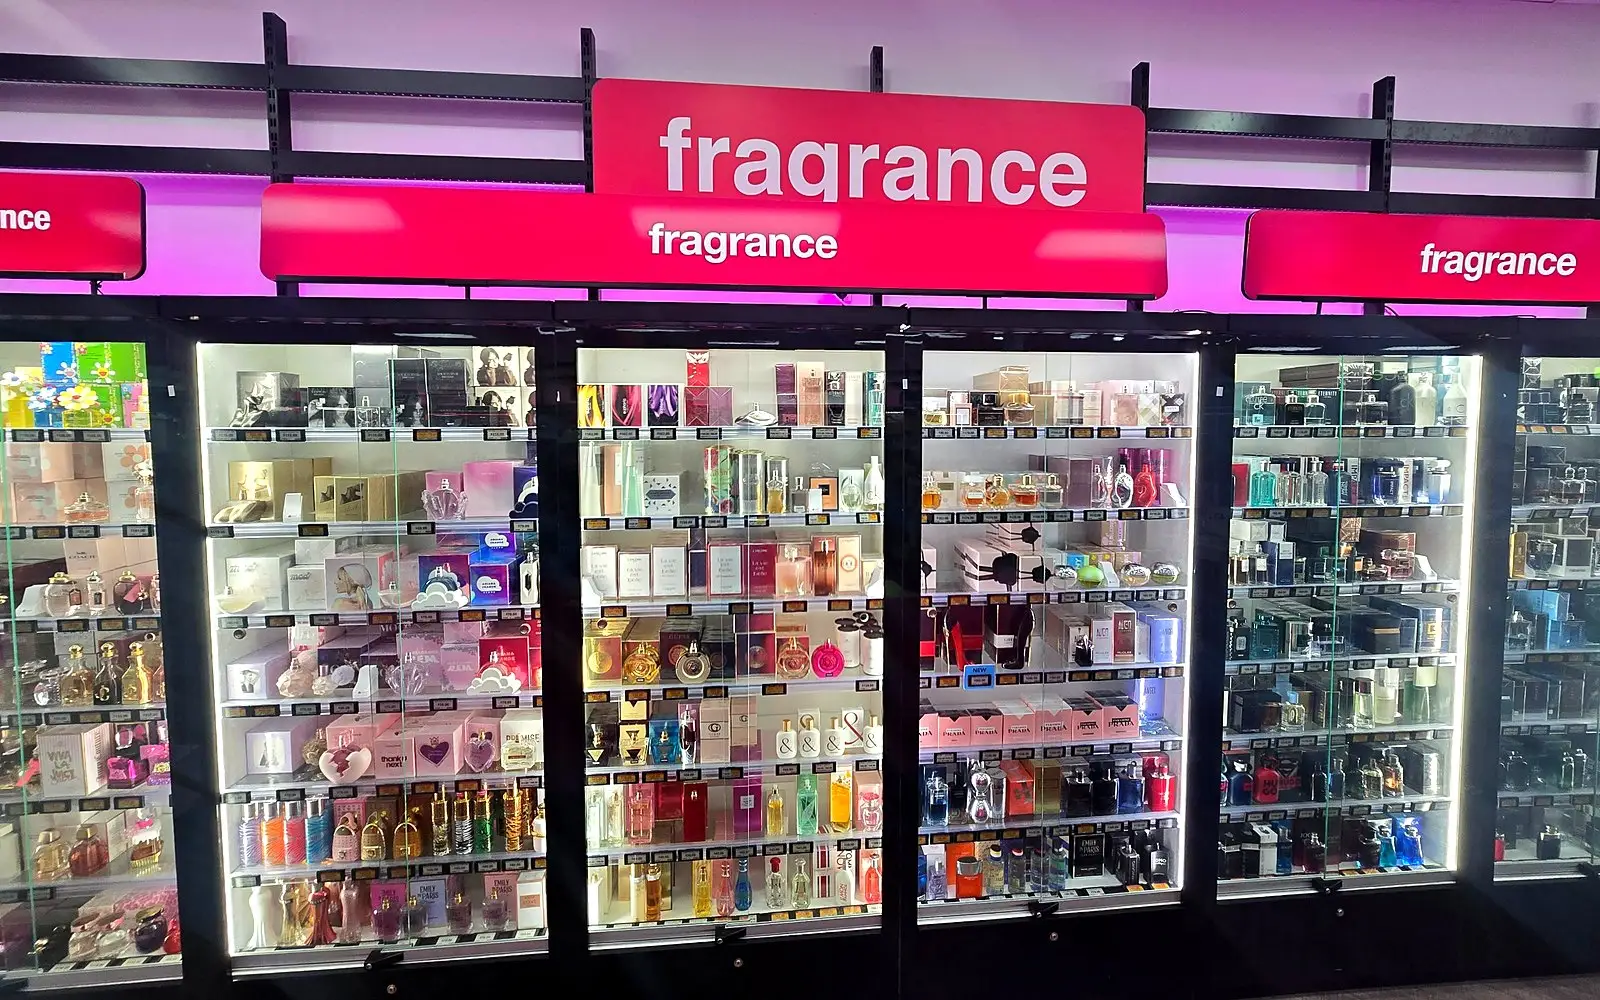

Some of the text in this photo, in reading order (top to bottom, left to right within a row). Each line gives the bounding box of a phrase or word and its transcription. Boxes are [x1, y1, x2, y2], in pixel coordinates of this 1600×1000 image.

[649, 223, 838, 264] fragrance
[1420, 242, 1577, 282] fragrance
[494, 879, 510, 887] EMILY
[420, 885, 436, 893] EMILY
[421, 892, 439, 900] PARIS
